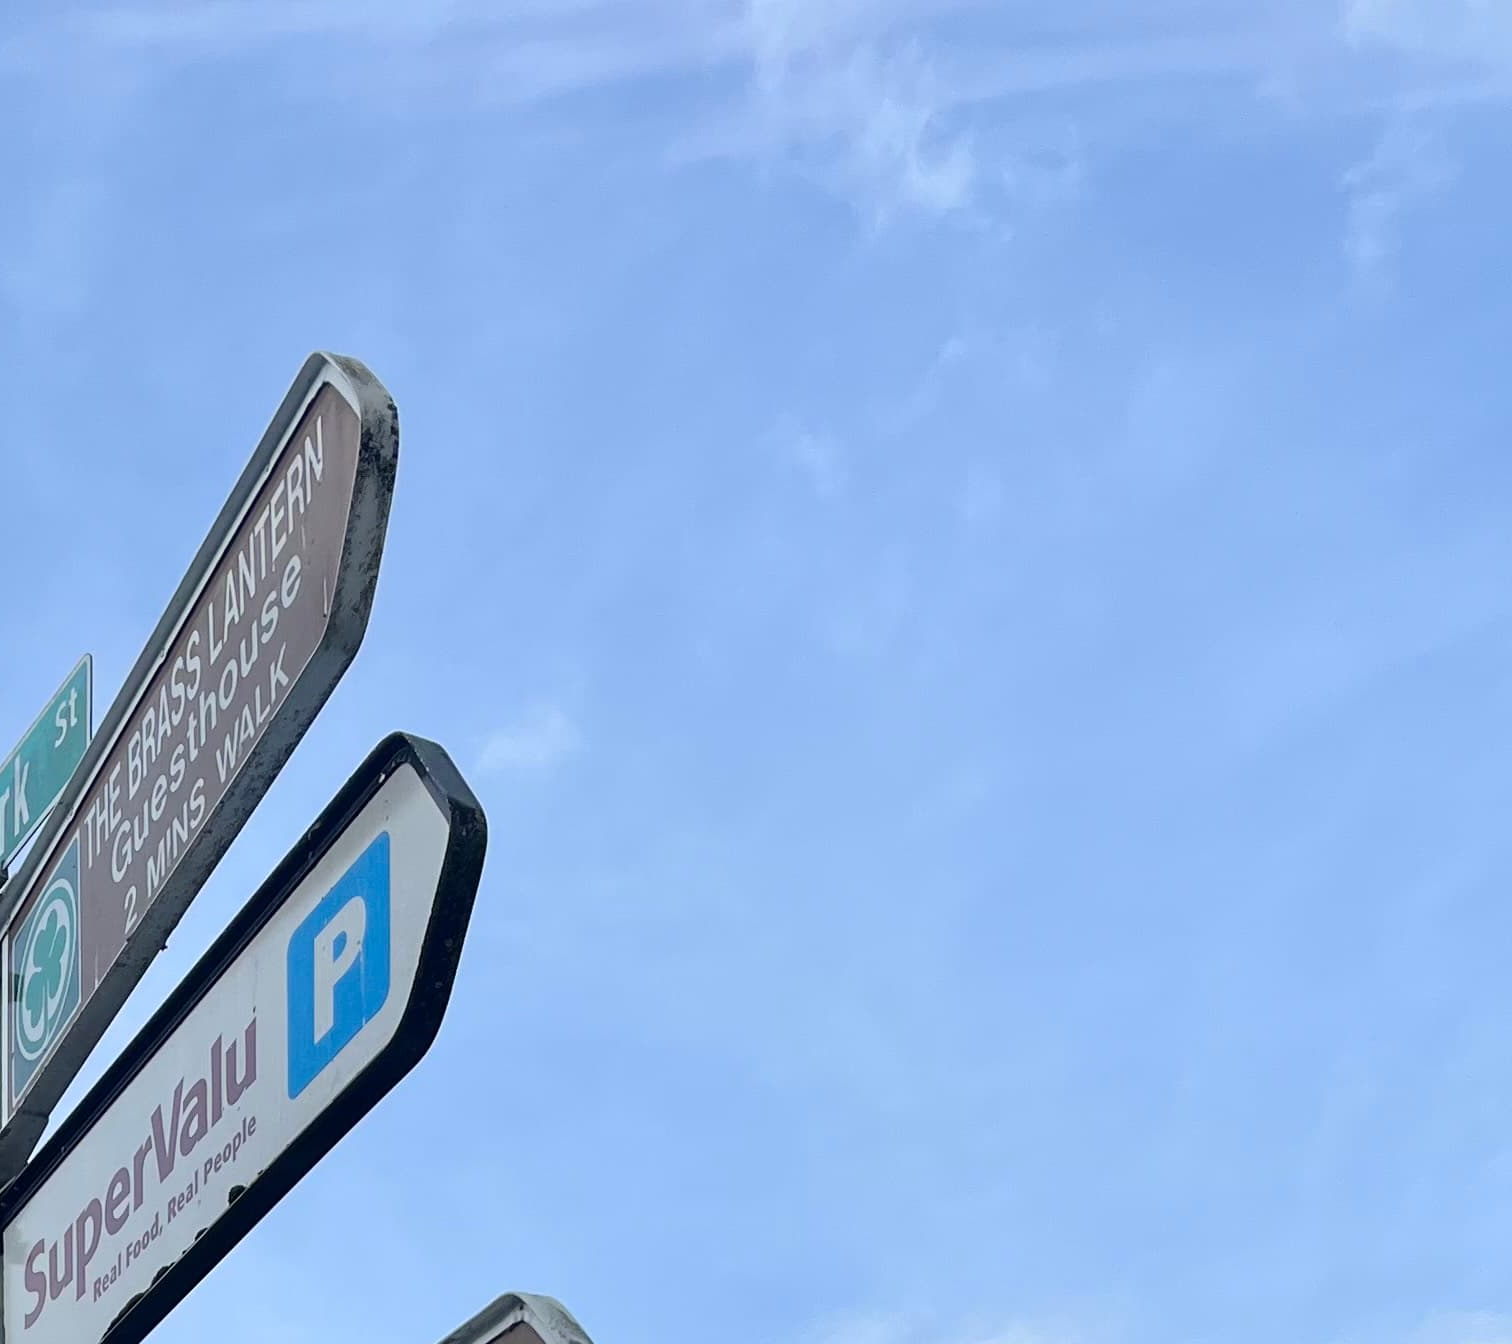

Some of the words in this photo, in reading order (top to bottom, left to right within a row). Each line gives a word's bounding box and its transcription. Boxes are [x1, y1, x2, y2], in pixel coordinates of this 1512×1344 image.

[54, 687, 78, 748] St
[84, 759, 122, 869] THE
[128, 629, 201, 801] BRASS
[207, 415, 324, 657] LANTERN
[110, 554, 301, 883] Guesthouse
[123, 885, 138, 936] 2
[146, 777, 206, 899] MINS
[215, 642, 289, 786] WALK
[313, 895, 366, 1045] P
[23, 1013, 257, 1329] SuperValu
[93, 1252, 123, 1302] Real
[125, 1217, 164, 1279] Food,
[167, 1171, 198, 1226] Real
[203, 1114, 257, 1187] People
